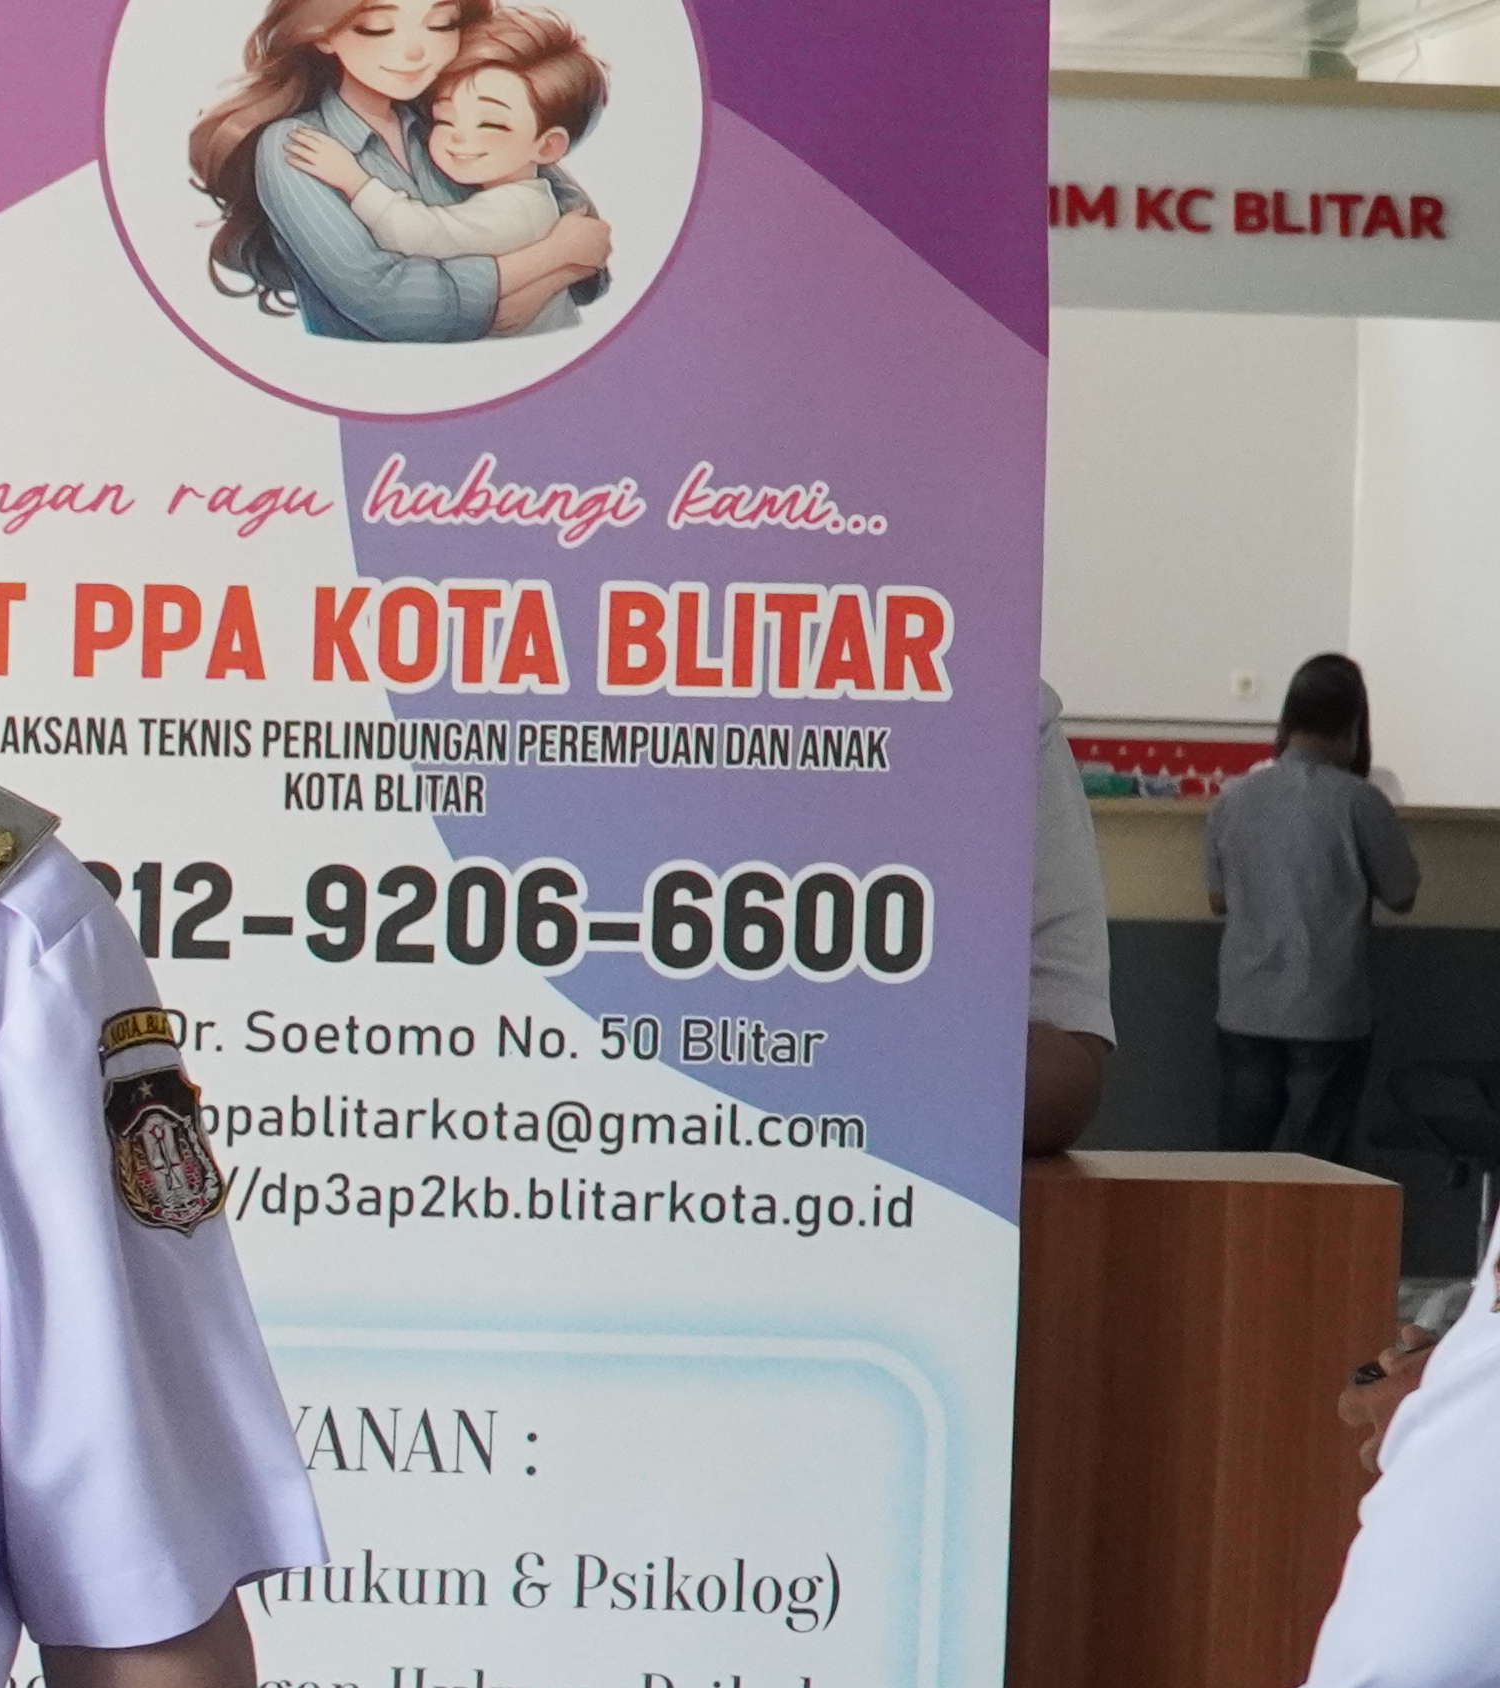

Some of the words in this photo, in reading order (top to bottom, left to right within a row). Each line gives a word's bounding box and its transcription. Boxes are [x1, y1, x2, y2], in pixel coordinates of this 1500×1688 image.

[1136, 186, 1215, 235] KC
[1234, 190, 1447, 241] BLITAR
[167, 480, 334, 539] ragu
[366, 454, 645, 546] hubungi
[671, 462, 887, 534] kami...
[73, 582, 267, 681] PPA
[312, 585, 561, 687] KOTA
[606, 589, 946, 693] BLITAR
[139, 718, 253, 758] TEKNIS
[261, 720, 507, 763] PERLINDUNGAN
[519, 724, 715, 766] PEREMPUAN
[726, 727, 791, 768] DAN
[800, 730, 890, 770] ANAK
[284, 773, 364, 812] KOTA
[374, 774, 486, 814] BLITAR
[244, 1008, 476, 1058] Soetomo
[498, 1015, 579, 1062] No.
[601, 1017, 661, 1062] 50
[682, 1019, 827, 1068] Blitar
[512, 1551, 552, 1610] &
[575, 1551, 842, 1635] Psikolog)
